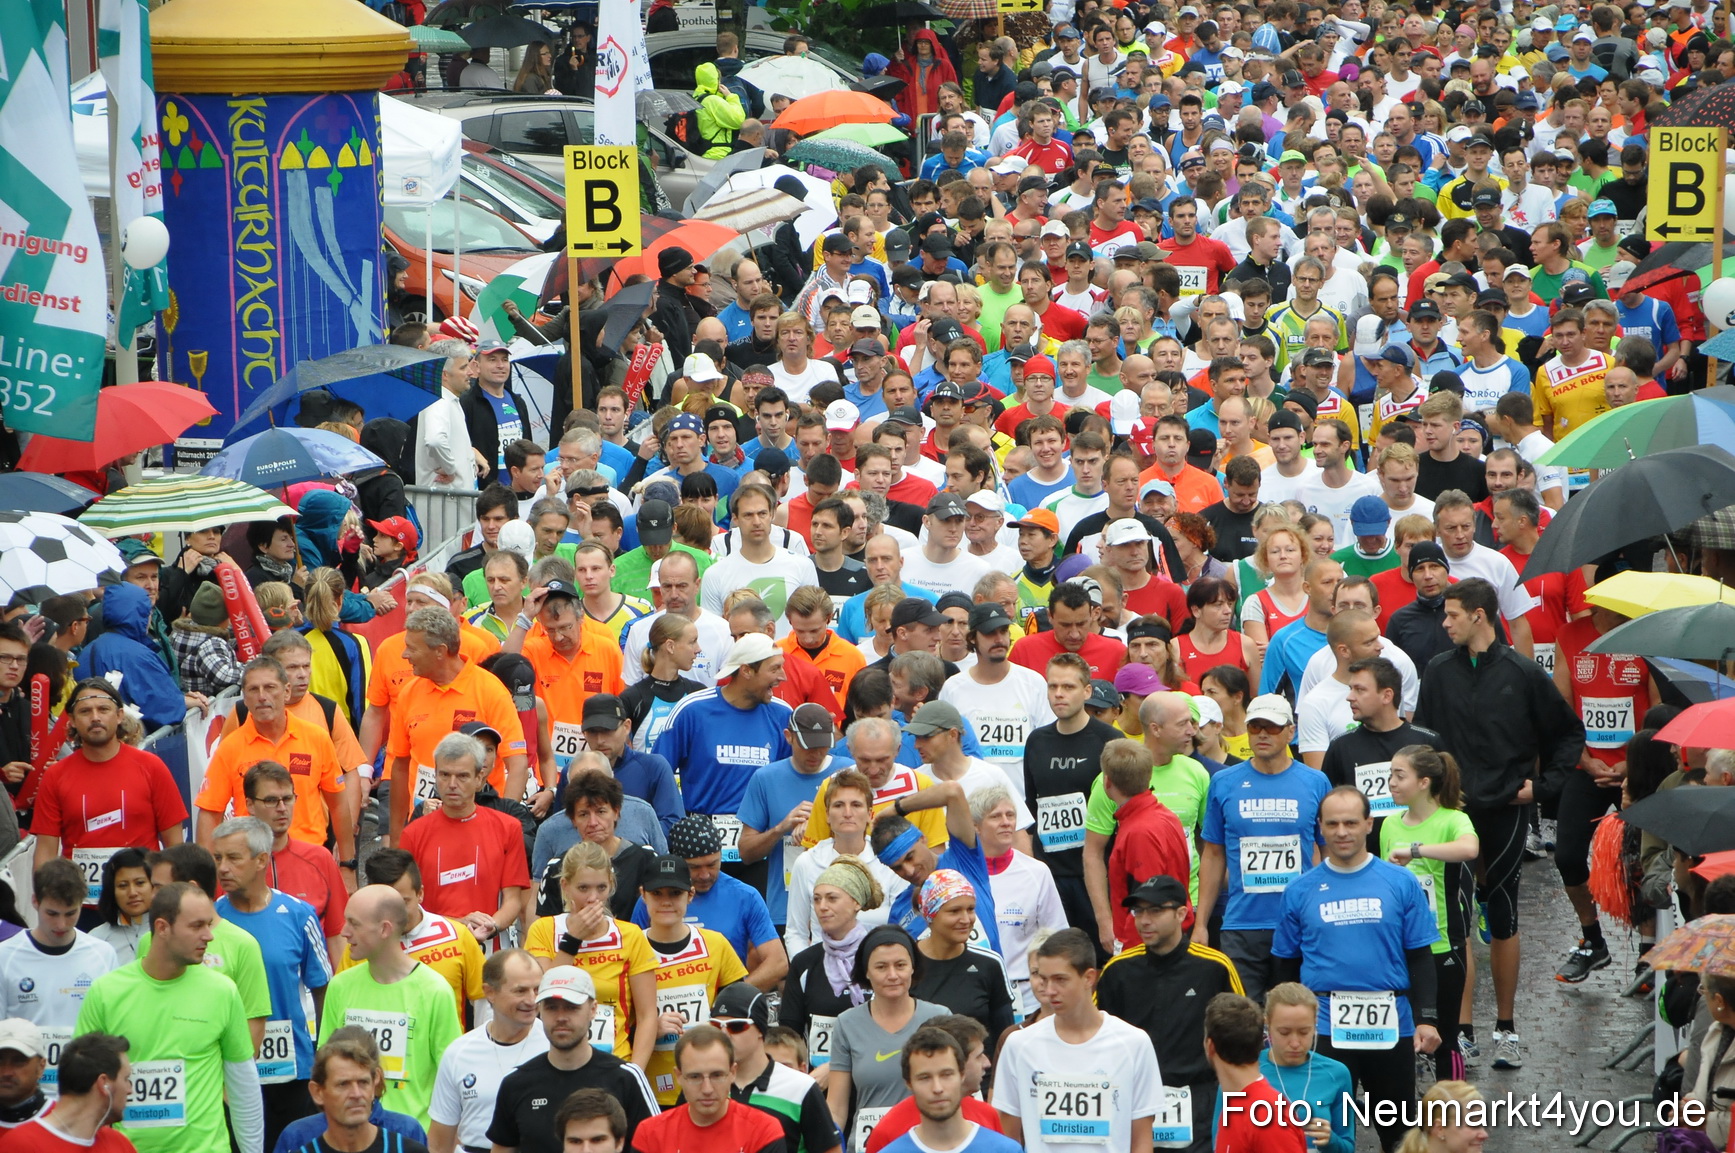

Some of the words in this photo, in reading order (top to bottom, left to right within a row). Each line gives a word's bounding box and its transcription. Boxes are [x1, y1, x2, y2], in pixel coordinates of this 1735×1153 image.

[1659, 132, 1718, 152] Block
[573, 150, 629, 169] Block
[1667, 162, 1705, 216] B
[584, 179, 622, 232] B
[1552, 384, 1577, 397] MAX
[1586, 711, 1628, 729] 2897
[980, 724, 1023, 743] 2401
[556, 736, 588, 755] 267
[717, 745, 769, 760] HUBER
[991, 748, 1013, 756] Marco
[1050, 757, 1075, 770] run
[1051, 800, 1075, 808] Neumarkt
[1239, 799, 1298, 811] HUBER
[1042, 807, 1083, 831] 2480
[1048, 833, 1078, 844] Manfred
[1247, 850, 1296, 871] 2776
[1254, 875, 1289, 885] Matthias
[1320, 898, 1382, 916] HUBER
[1334, 912, 1379, 920] TECHNOLOGY
[419, 947, 462, 965] BÖGL
[589, 952, 624, 965] BÖGL
[656, 971, 675, 983] AX
[679, 963, 714, 979] BÖGL
[664, 992, 696, 1001] Neumarkt
[365, 1017, 396, 1026] Neumarkt
[1338, 1004, 1392, 1025] 2767
[1346, 1031, 1384, 1040] Bernhard
[137, 1066, 171, 1075] Neumarkt
[1045, 1091, 1101, 1117] 2461
[129, 1107, 169, 1119] Christoph
[1051, 1123, 1094, 1134] Christian
